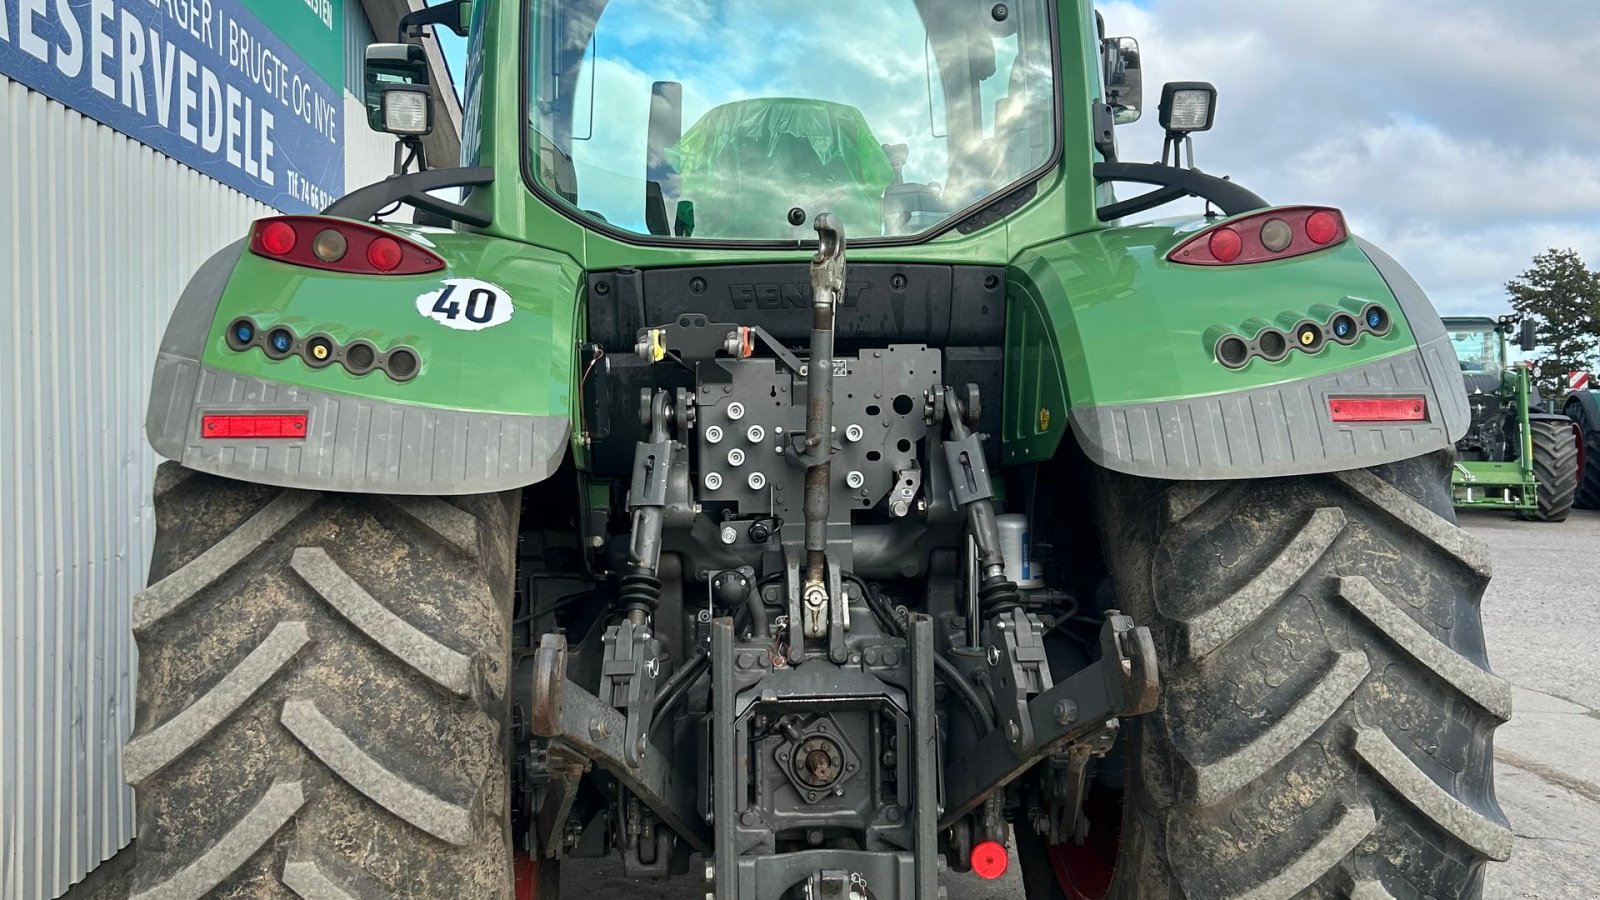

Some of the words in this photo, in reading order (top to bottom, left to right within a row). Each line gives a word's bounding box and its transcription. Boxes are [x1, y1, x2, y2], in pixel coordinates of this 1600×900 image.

[148, 0, 214, 50] GER
[229, 17, 289, 107] BRUGTE
[292, 74, 311, 124] OG
[314, 91, 336, 144] NYE
[0, 0, 274, 187] ESERVEDELE
[300, 177, 310, 204] 74
[310, 183, 319, 210] 66
[432, 284, 497, 324] 40
[728, 282, 870, 310] FENT
